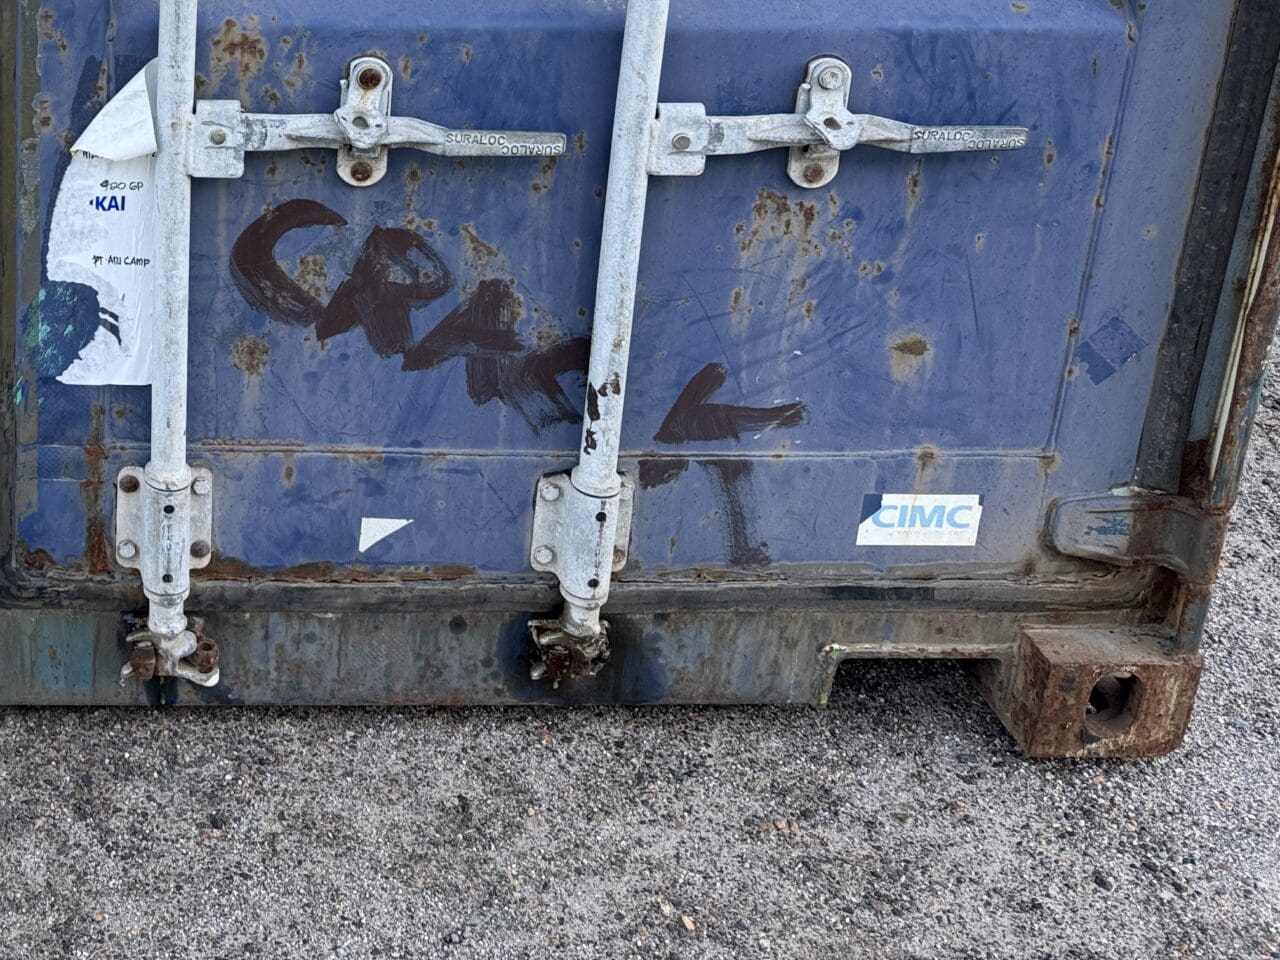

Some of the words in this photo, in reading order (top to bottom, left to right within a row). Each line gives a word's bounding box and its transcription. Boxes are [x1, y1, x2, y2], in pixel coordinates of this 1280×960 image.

[446, 133, 507, 146] SURALOC
[913, 130, 970, 142] SURALOC
[501, 144, 562, 156] SURALOC
[871, 505, 973, 529] CIMC
